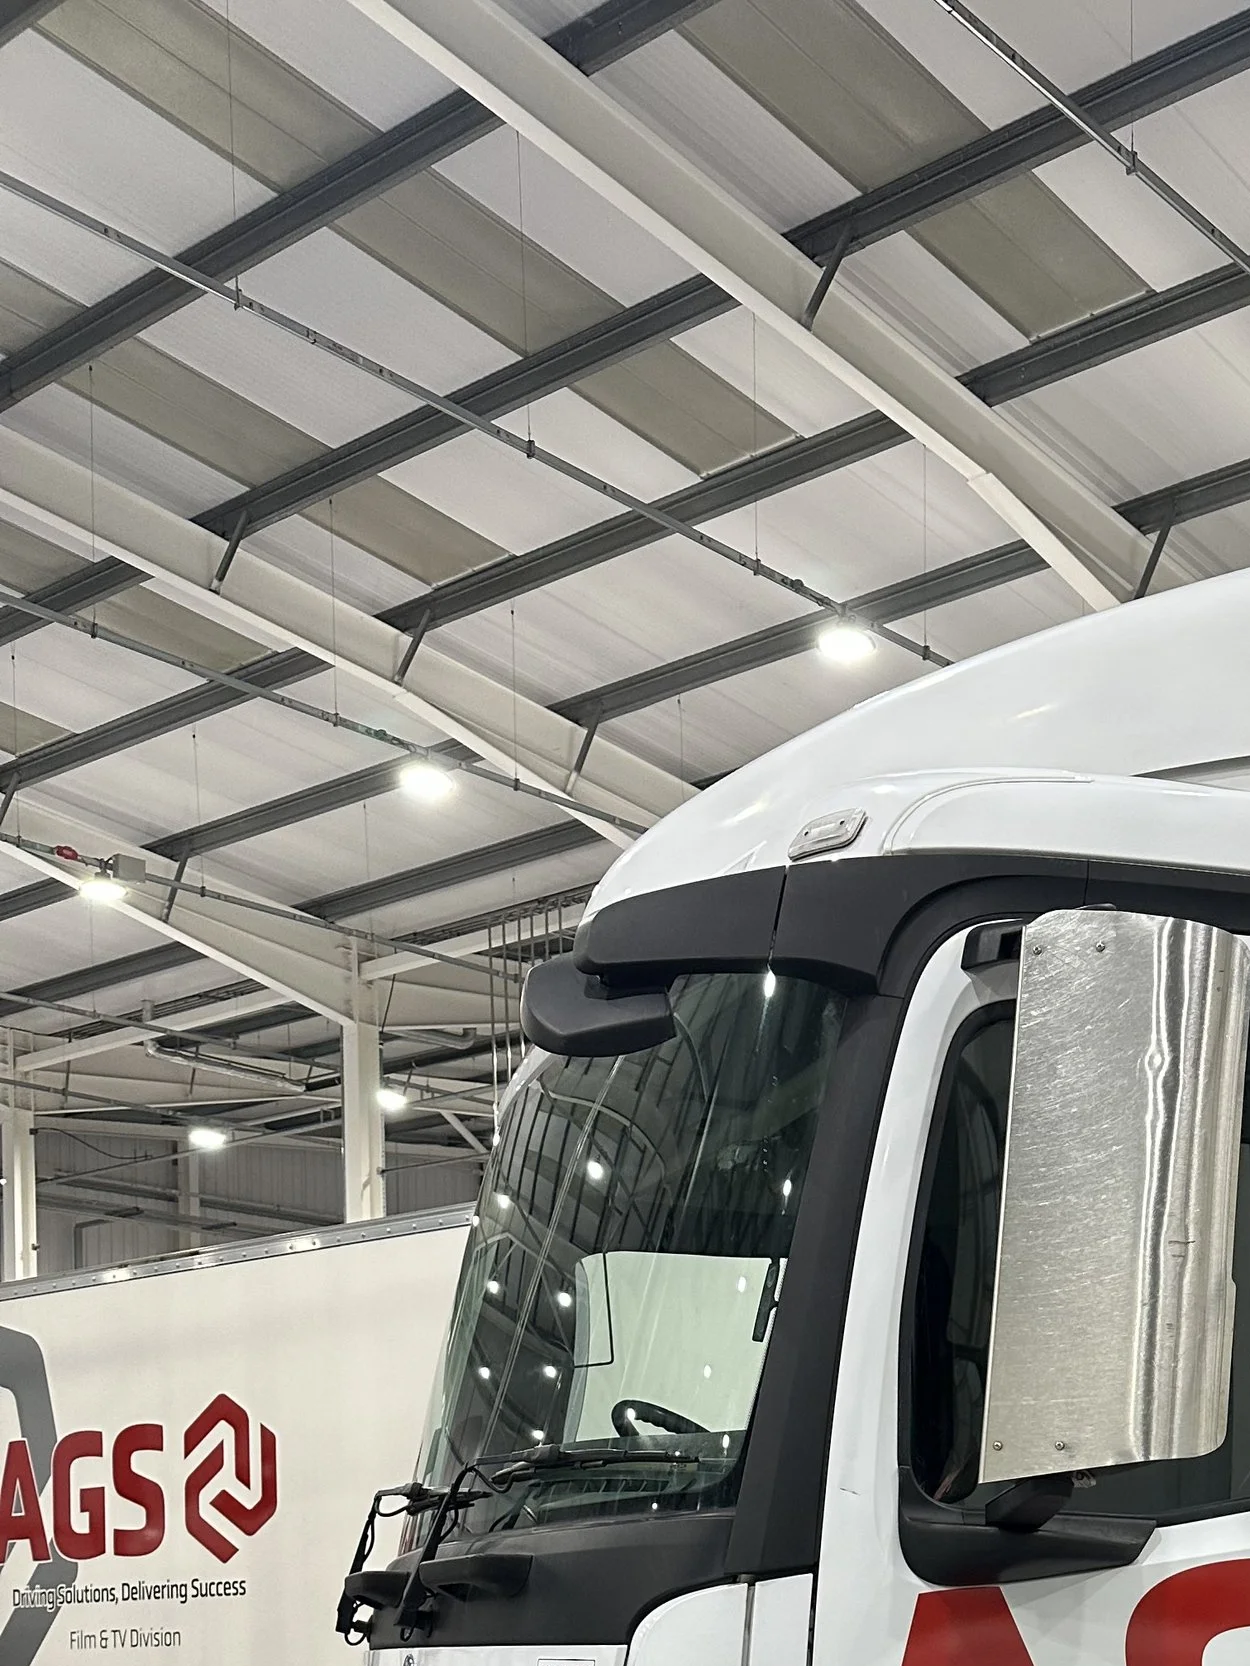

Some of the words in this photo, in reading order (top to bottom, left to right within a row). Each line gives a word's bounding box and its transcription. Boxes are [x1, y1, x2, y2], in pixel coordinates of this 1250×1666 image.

[0, 1422, 165, 1564] AGS
[12, 1584, 55, 1611] Driving
[57, 1582, 119, 1605] Solutions,
[121, 1579, 188, 1604] Delivering
[191, 1578, 247, 1599] Success
[70, 1630, 97, 1650] Film
[100, 1630, 109, 1649] &
[111, 1629, 128, 1648] TV
[130, 1627, 181, 1648] Division
